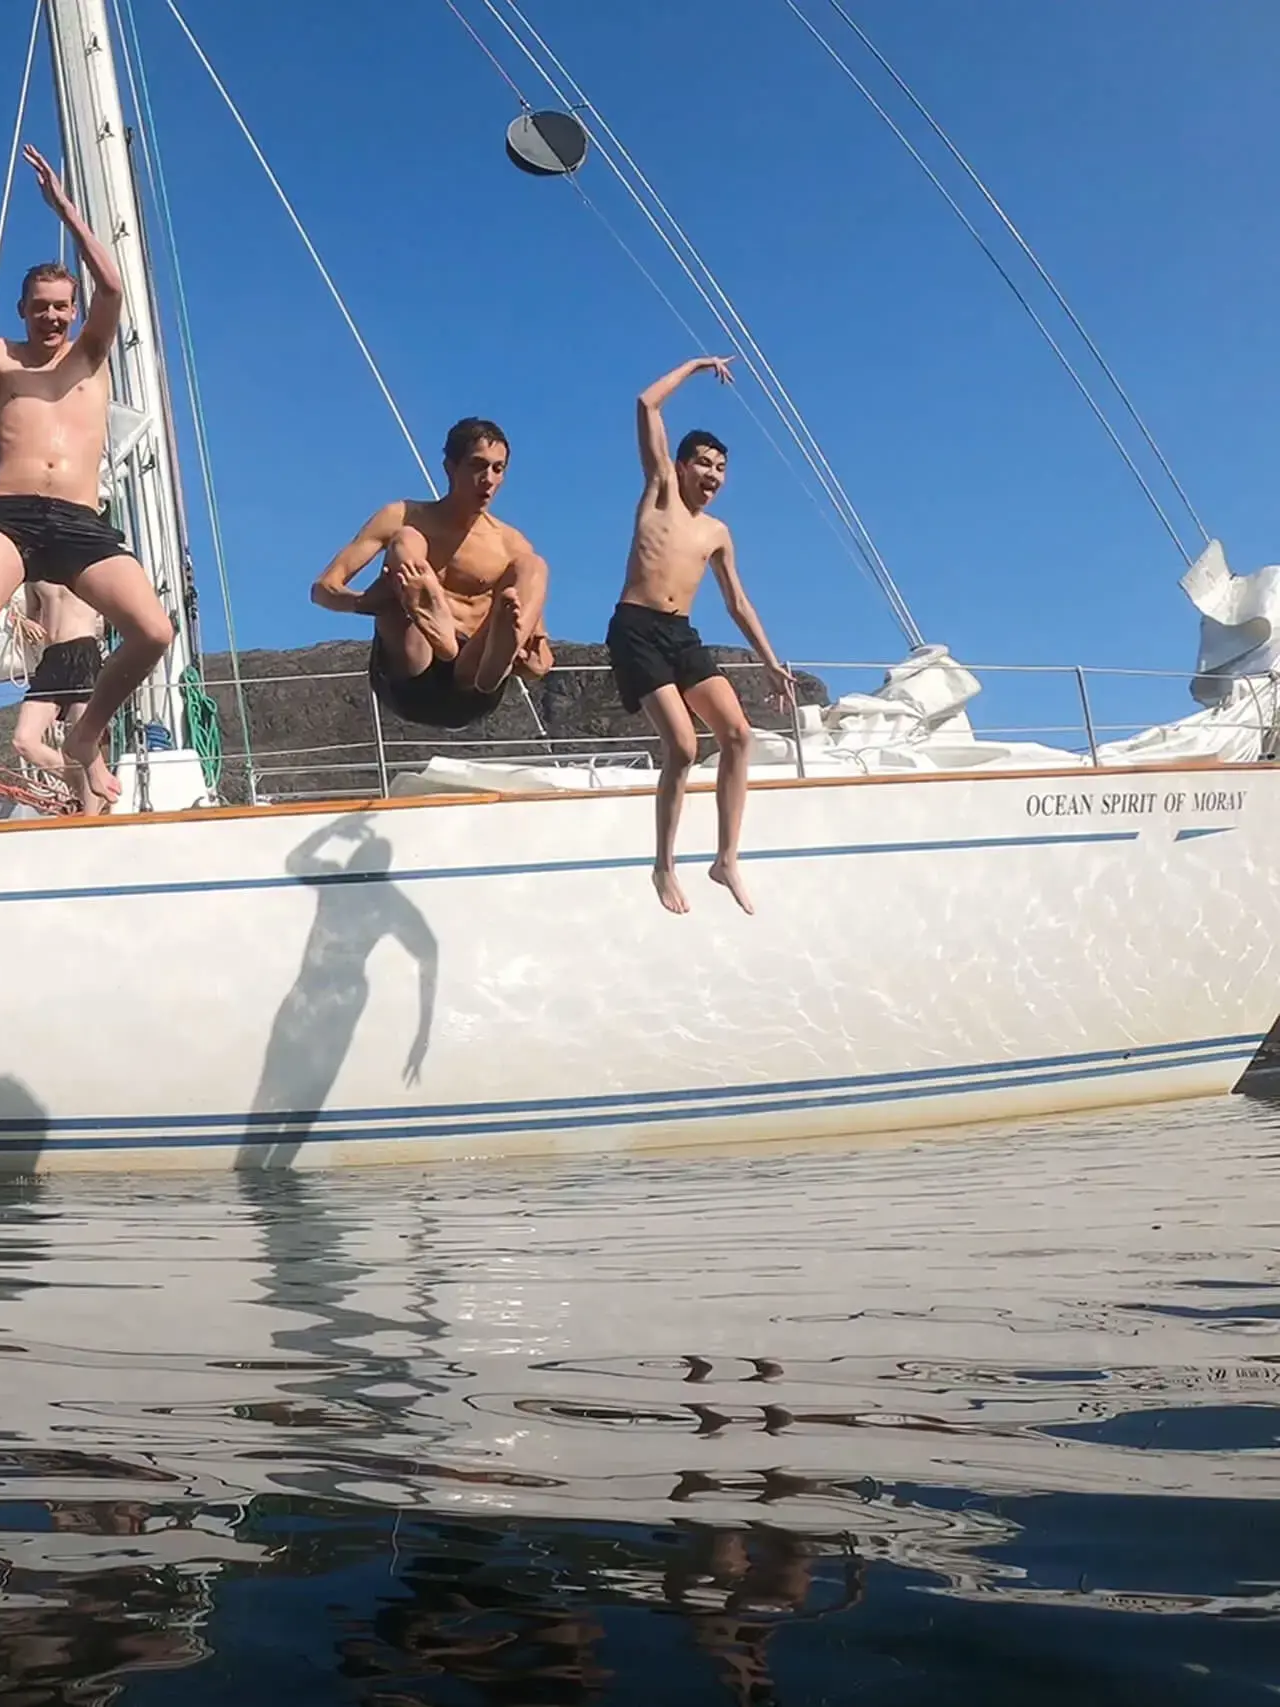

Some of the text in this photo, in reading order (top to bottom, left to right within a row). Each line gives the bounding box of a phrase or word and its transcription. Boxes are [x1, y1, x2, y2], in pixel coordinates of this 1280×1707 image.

[1026, 791, 1246, 816] OCEAN SPIRIT OF MORAY
